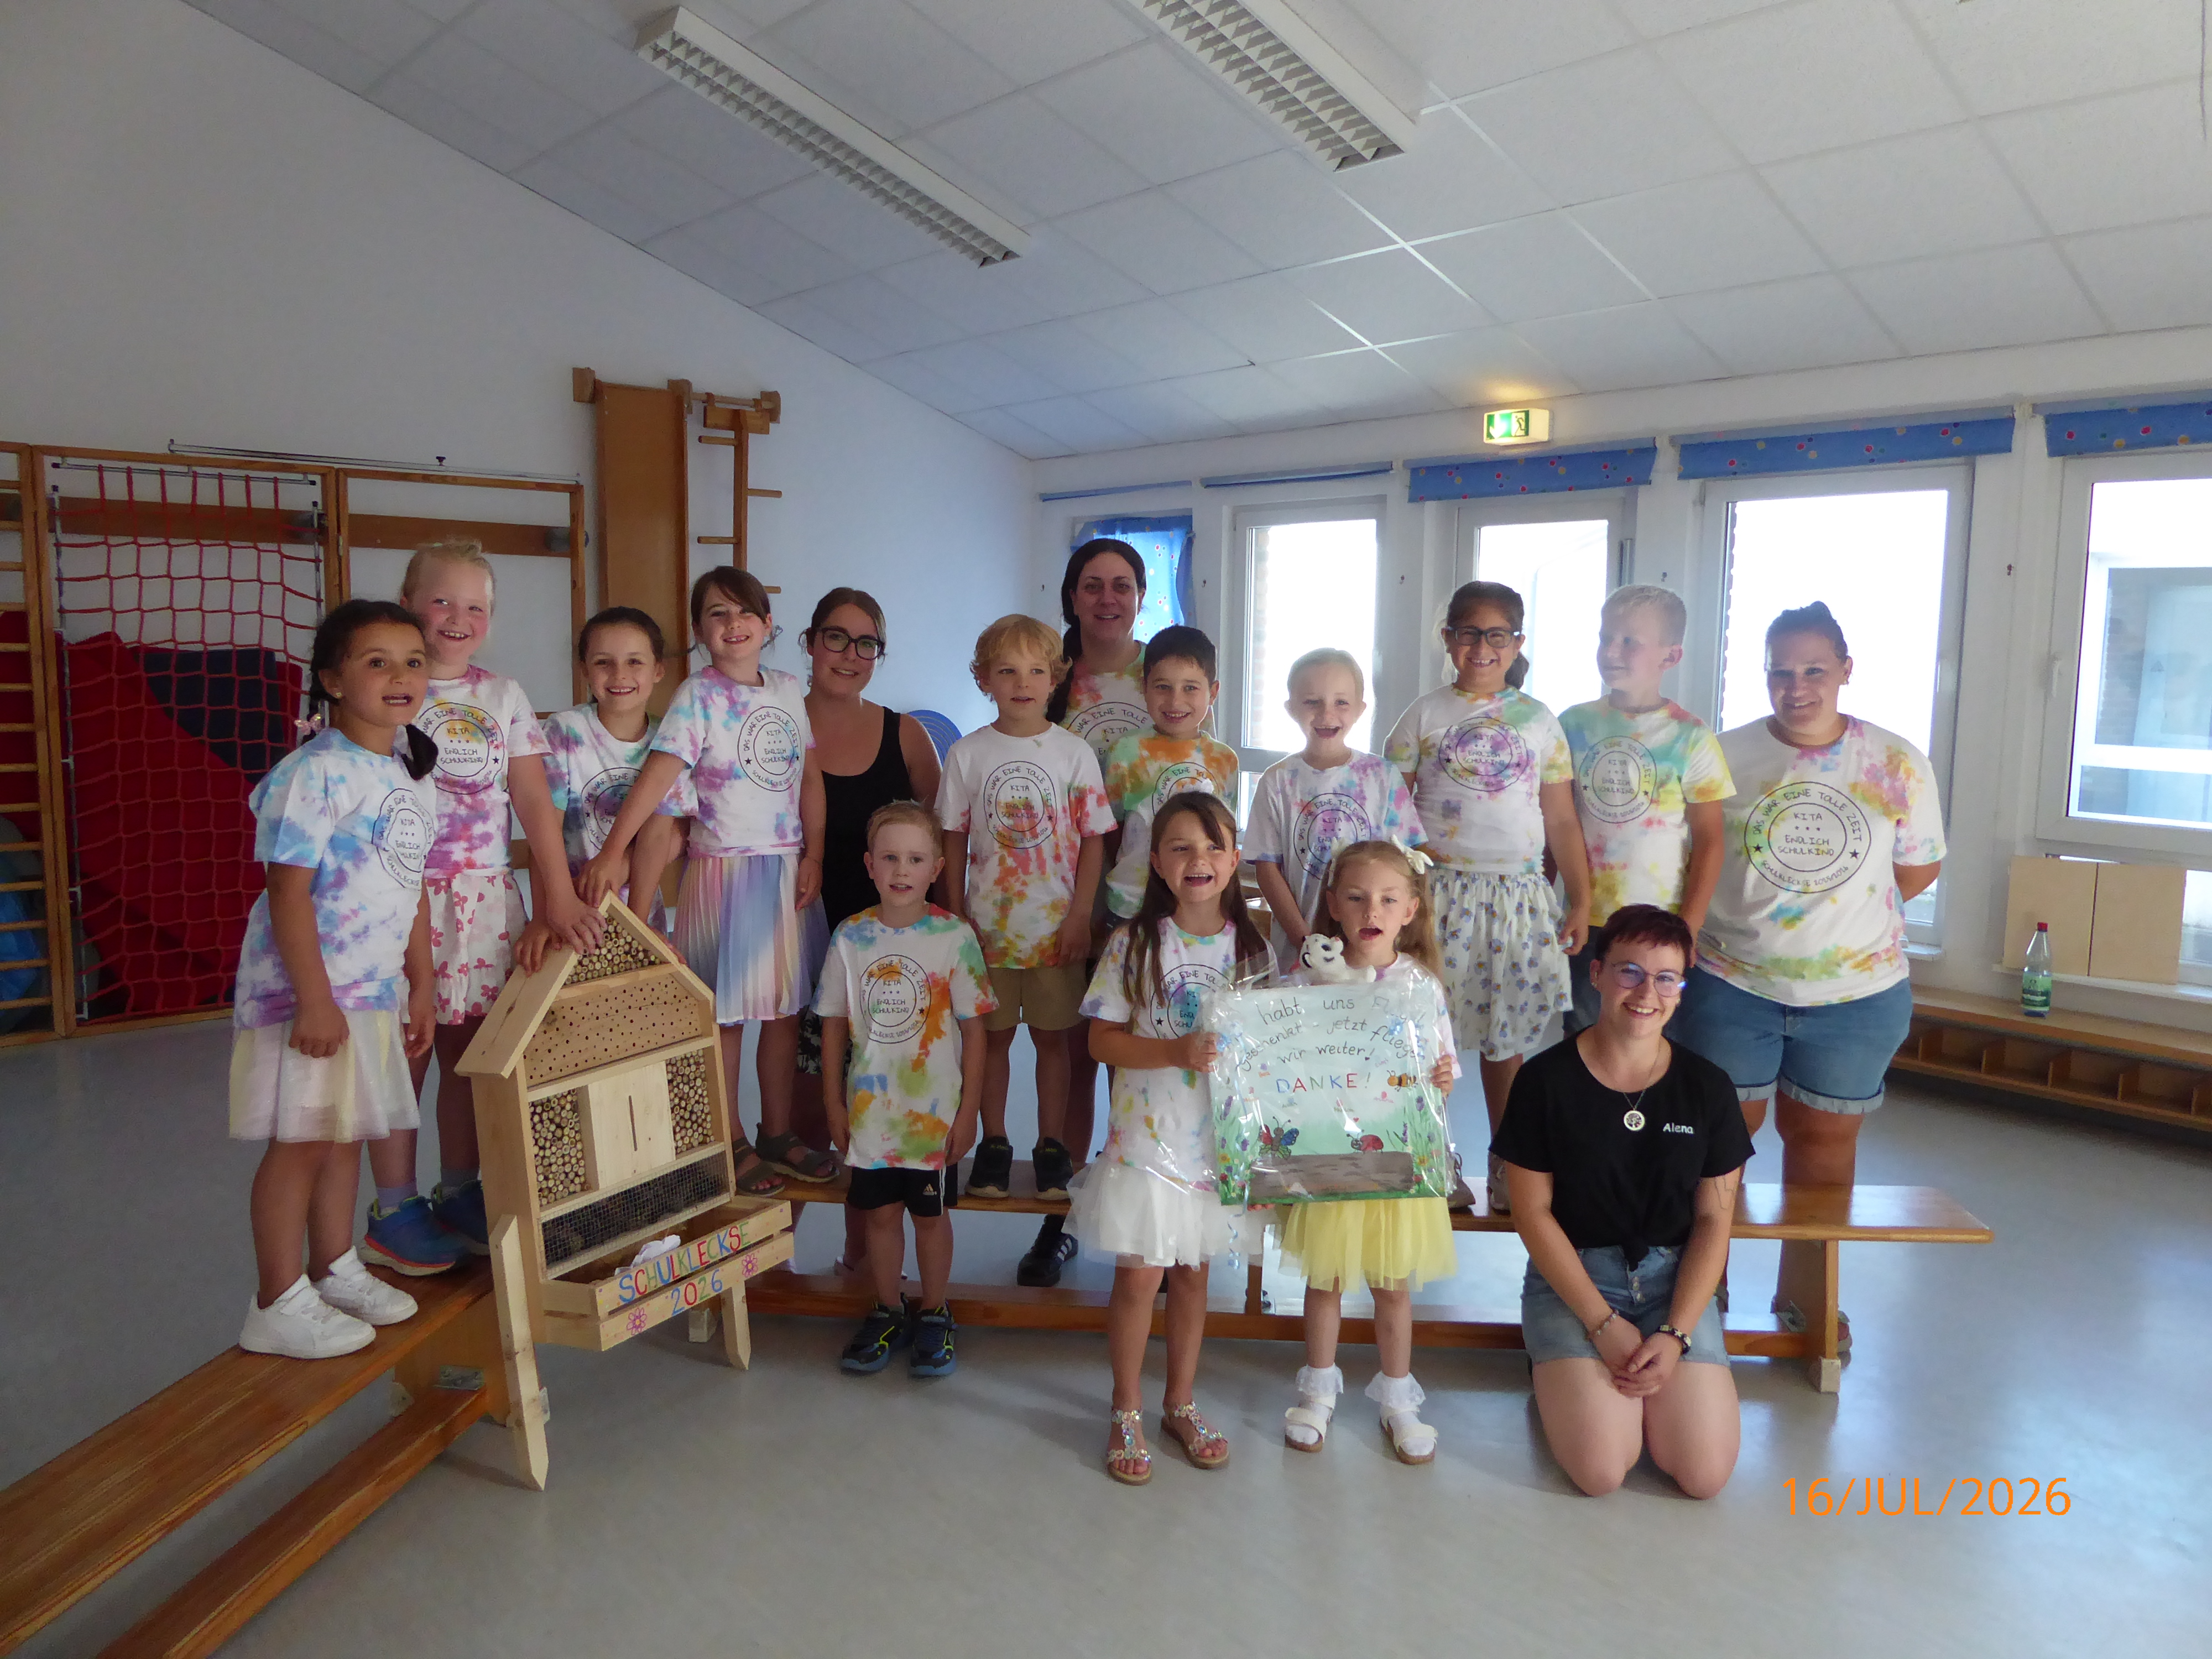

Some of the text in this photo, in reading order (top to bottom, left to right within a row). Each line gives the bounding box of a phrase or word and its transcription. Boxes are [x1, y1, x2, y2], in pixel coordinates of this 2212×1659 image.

[422, 717, 435, 733] WAR
[434, 708, 457, 718] EINE
[462, 709, 487, 724] TOLLE
[747, 722, 757, 736] WAR
[755, 711, 771, 722] EINE
[773, 713, 790, 726] TOLLE
[1076, 708, 1148, 733] WAR EINE TOLLE
[592, 778, 607, 791] WAR
[609, 773, 628, 783] EINE
[990, 775, 1001, 790] WAR
[1002, 766, 1021, 776] EINE
[1026, 768, 1045, 784] TOLLE
[1162, 775, 1172, 790] WAR
[1172, 766, 1190, 776] EINE
[1194, 768, 1207, 779] TOL
[1314, 799, 1333, 809] EINE
[1338, 800, 1358, 813] TOLLE
[1753, 789, 1861, 841] DAS WAR EINE TOLLE ZEIT
[1778, 846, 1834, 856] SCHULKIND
[1786, 834, 1829, 846] ENDLICH
[865, 960, 926, 1001] WAR EINE TOLLE ZEIT
[1167, 977, 1178, 989] AR
[1179, 970, 1199, 978] EINE
[1255, 997, 1302, 1025] habt
[1323, 999, 1355, 1010] uns
[1327, 1016, 1367, 1035] jetzt
[1277, 1041, 1375, 1063] wir weiter!
[1663, 1123, 1693, 1134] Alena
[618, 1222, 750, 1303] SCHULKLECKSE
[671, 1269, 723, 1317] 2026
